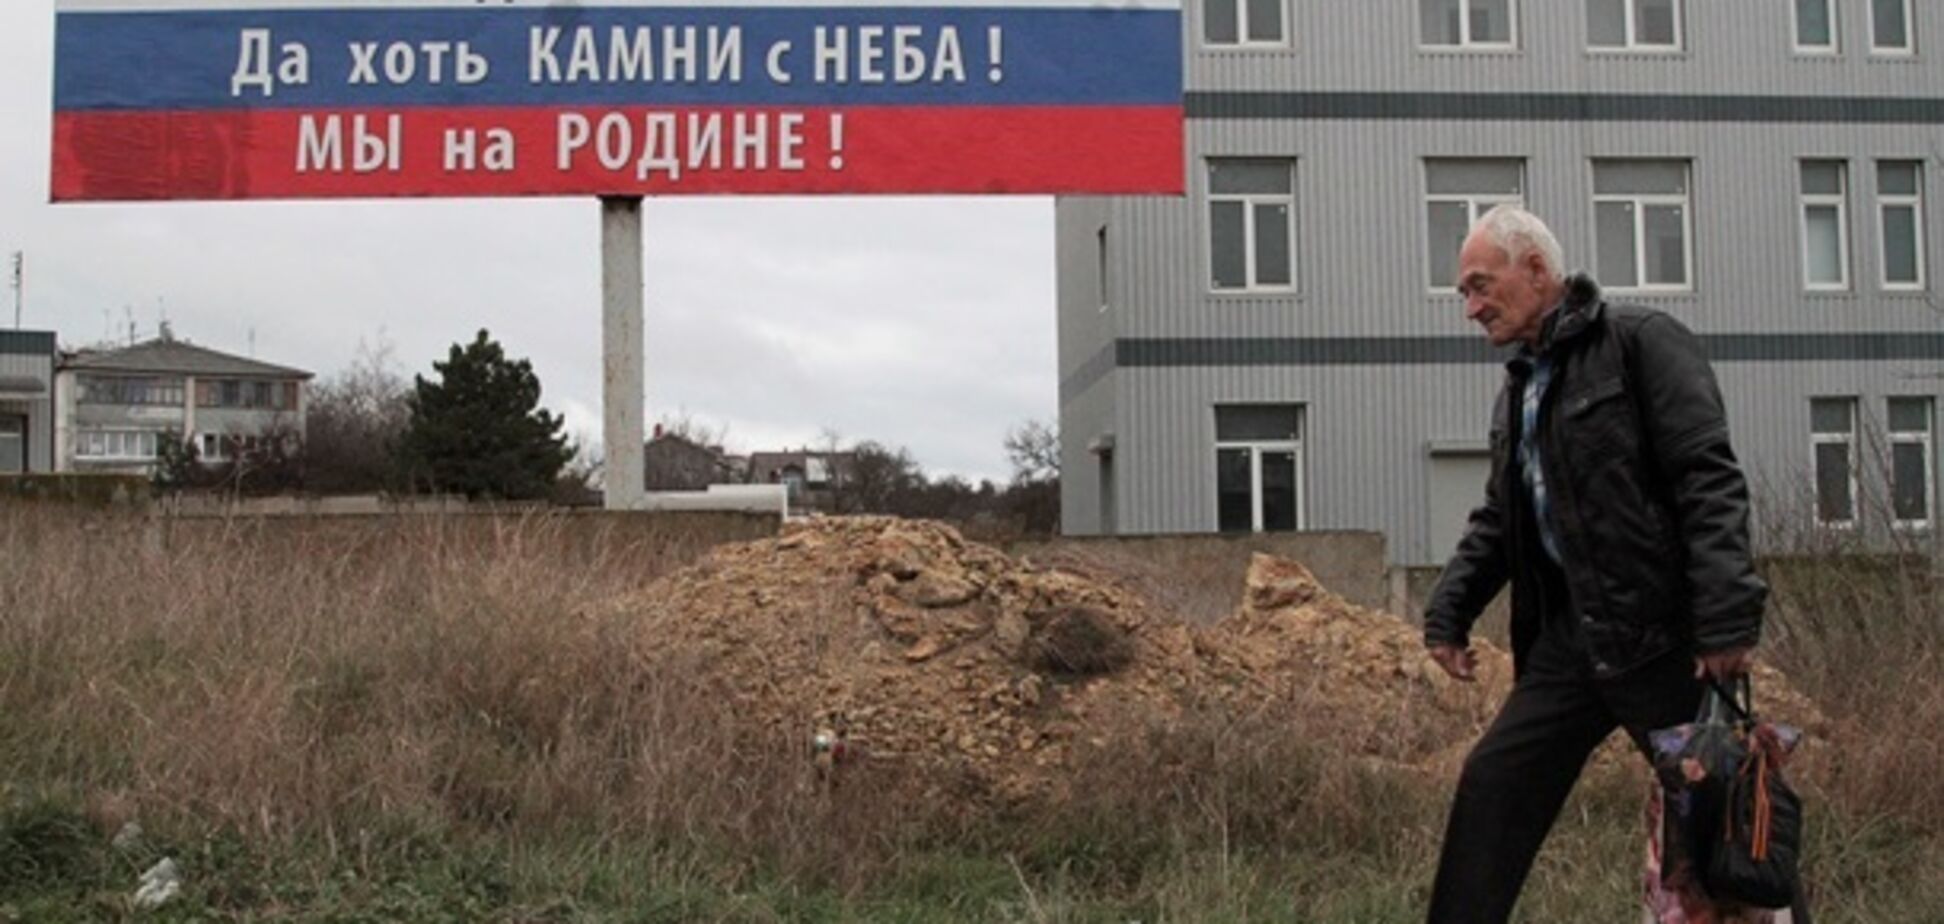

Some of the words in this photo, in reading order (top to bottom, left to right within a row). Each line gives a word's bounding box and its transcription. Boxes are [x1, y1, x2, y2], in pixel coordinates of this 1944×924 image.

[231, 28, 309, 96] Да
[346, 40, 489, 84] хоть
[529, 25, 742, 83] КАМНИ
[766, 39, 792, 83] с
[813, 25, 966, 83] НЕБА
[296, 114, 402, 171] МЫ
[444, 128, 515, 171] на
[558, 111, 805, 181] РОДИНЕ
